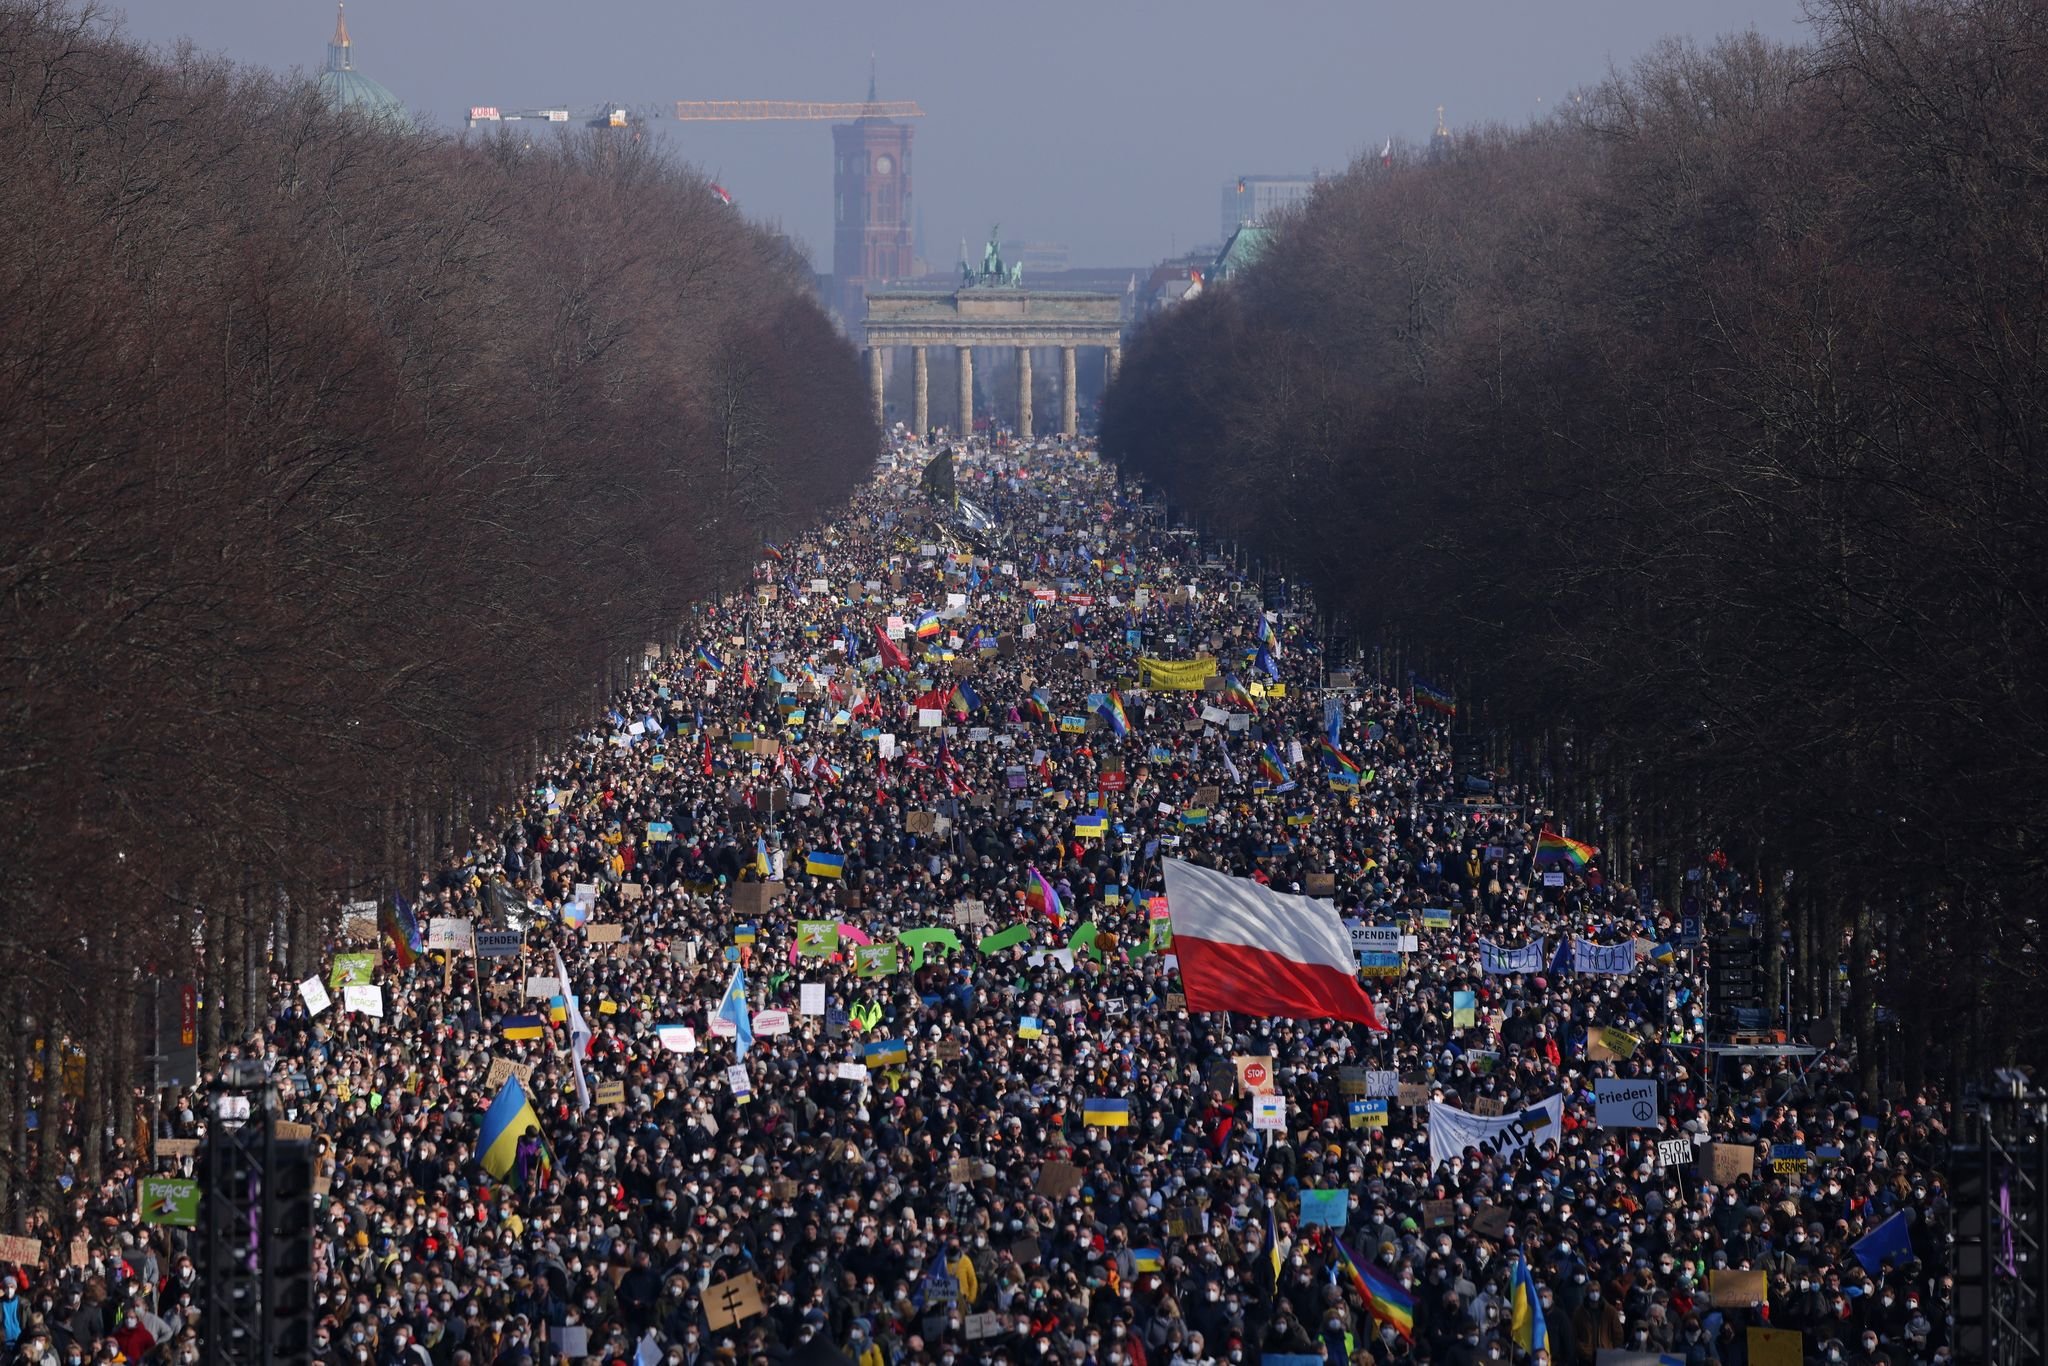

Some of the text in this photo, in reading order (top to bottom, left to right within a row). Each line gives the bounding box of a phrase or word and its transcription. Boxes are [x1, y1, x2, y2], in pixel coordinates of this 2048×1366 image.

[802, 923, 835, 934] PEACE
[1684, 918, 1694, 935] P
[478, 935, 519, 946] SPENDEN
[1351, 929, 1398, 941] SPENDEN
[860, 947, 893, 960] PEACE
[1577, 940, 1633, 971] FRIEDEN
[1247, 1069, 1264, 1079] STOP
[1367, 1071, 1398, 1085] STOP
[1369, 1084, 1394, 1097] WAR
[1598, 1085, 1653, 1105] Frieden!
[1354, 1103, 1380, 1112] STOP
[1362, 1115, 1380, 1123] WAR
[1659, 1140, 1689, 1155] STOP
[1664, 1152, 1693, 1165] PUTIN
[1774, 1160, 1807, 1172] UKRAINE
[149, 1183, 195, 1198] PEACE
